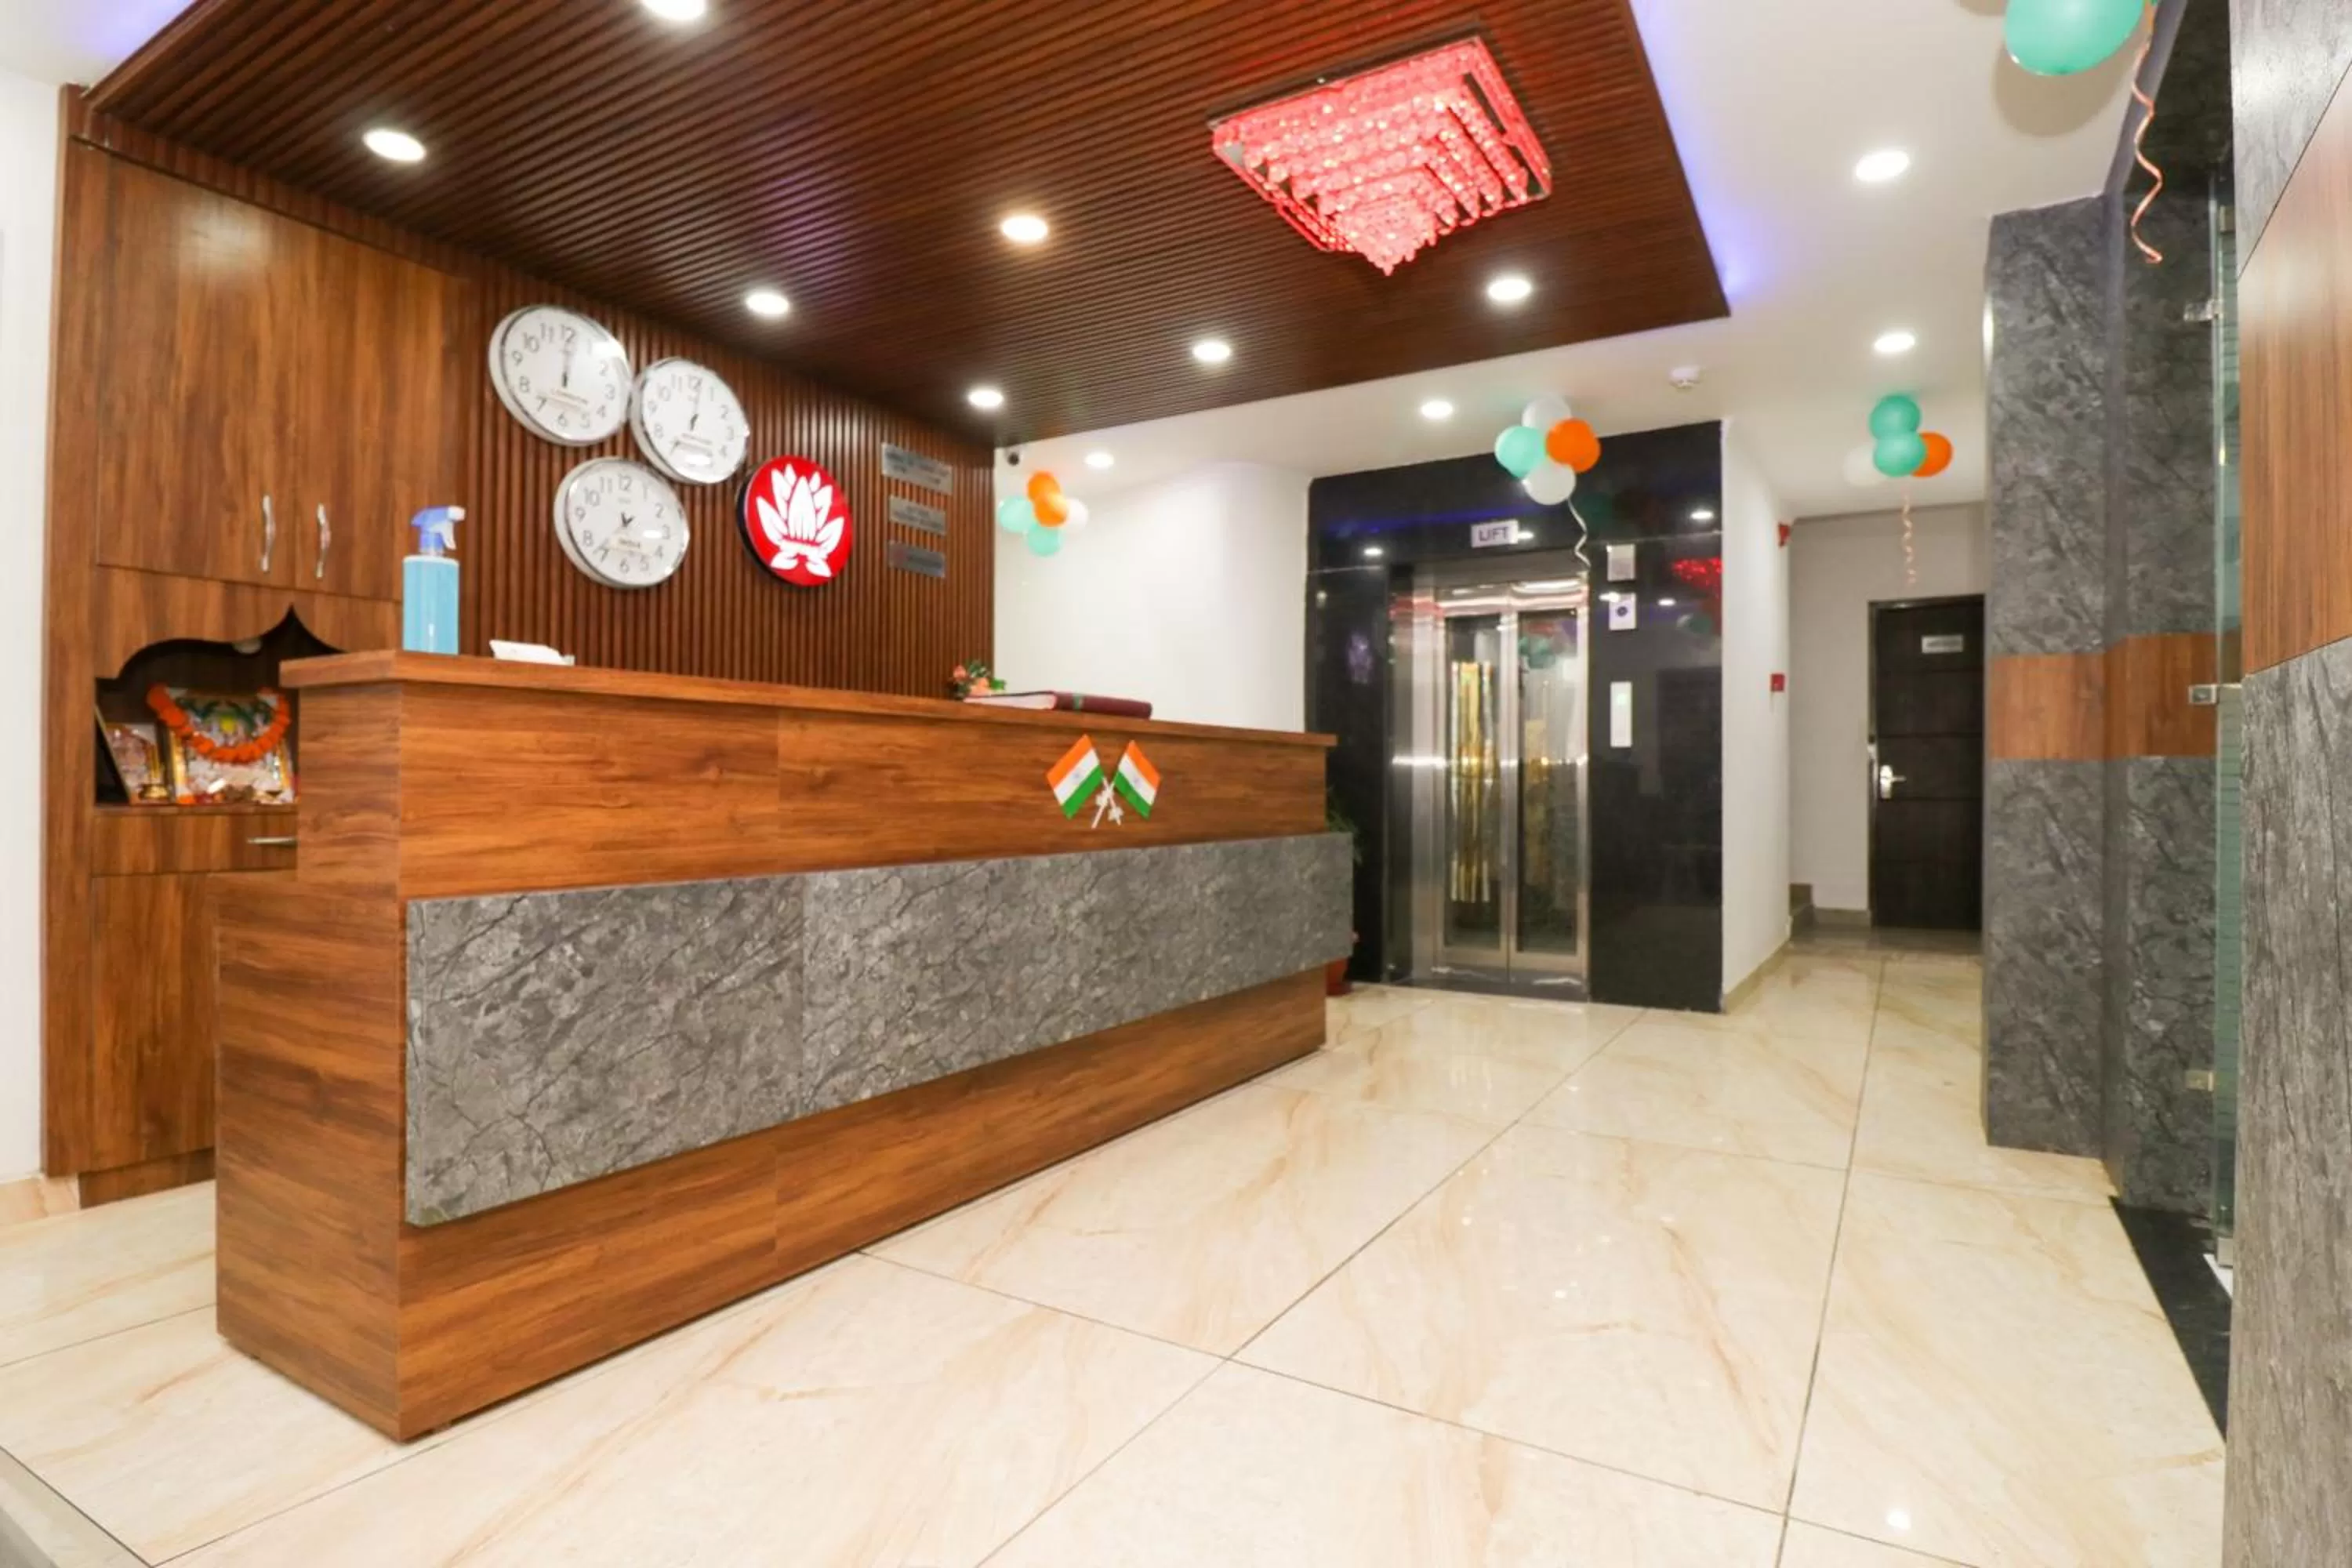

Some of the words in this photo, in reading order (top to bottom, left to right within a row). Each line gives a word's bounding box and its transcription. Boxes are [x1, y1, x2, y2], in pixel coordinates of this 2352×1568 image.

[523, 332, 539, 352] 10
[560, 324, 575, 343] 12
[512, 350, 523, 366] 9
[519, 376, 530, 393] 8
[604, 383, 615, 401] 3
[536, 394, 547, 412] 7
[557, 412, 568, 427] 6
[1479, 527, 1509, 541] LIFT
[619, 559, 630, 573] 6
